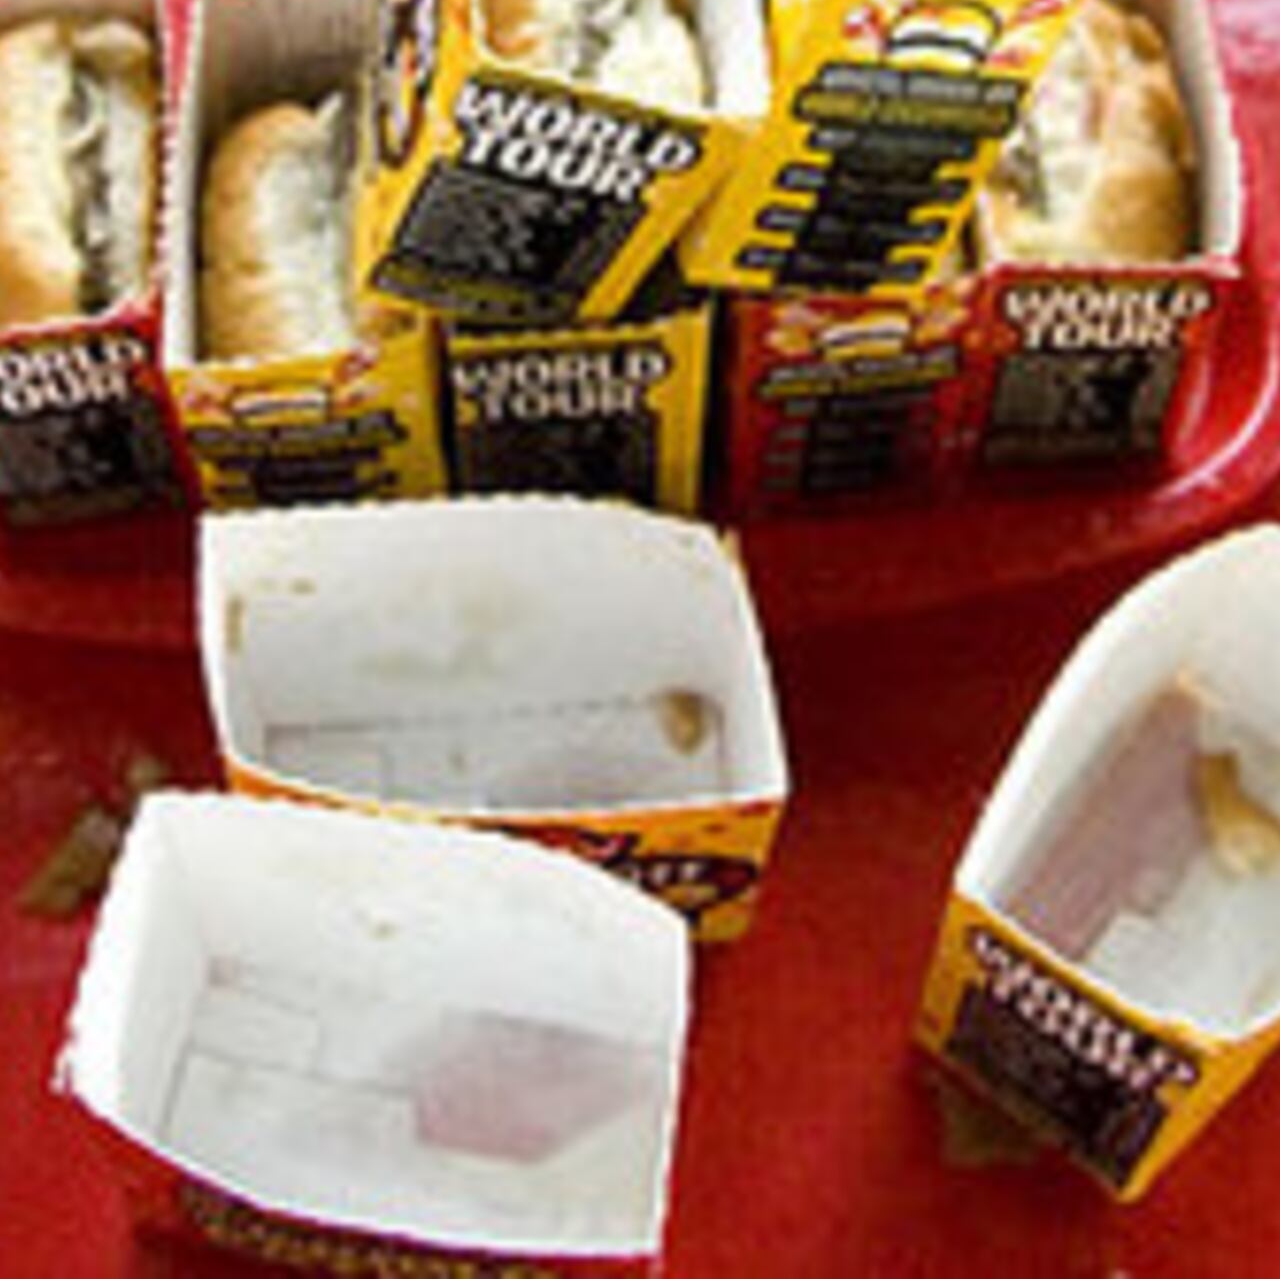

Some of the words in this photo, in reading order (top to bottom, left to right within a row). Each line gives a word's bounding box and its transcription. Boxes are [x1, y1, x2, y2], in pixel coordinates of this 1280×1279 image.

[455, 83, 697, 170] WORLD
[463, 127, 648, 202] TOUR
[1004, 282, 1211, 322] WORLD
[1023, 313, 1175, 350] TOUR
[453, 349, 667, 394] WORLD
[480, 378, 637, 420] TOUR
[974, 931, 1197, 1084] WORLD
[990, 972, 1150, 1090] TOUR
